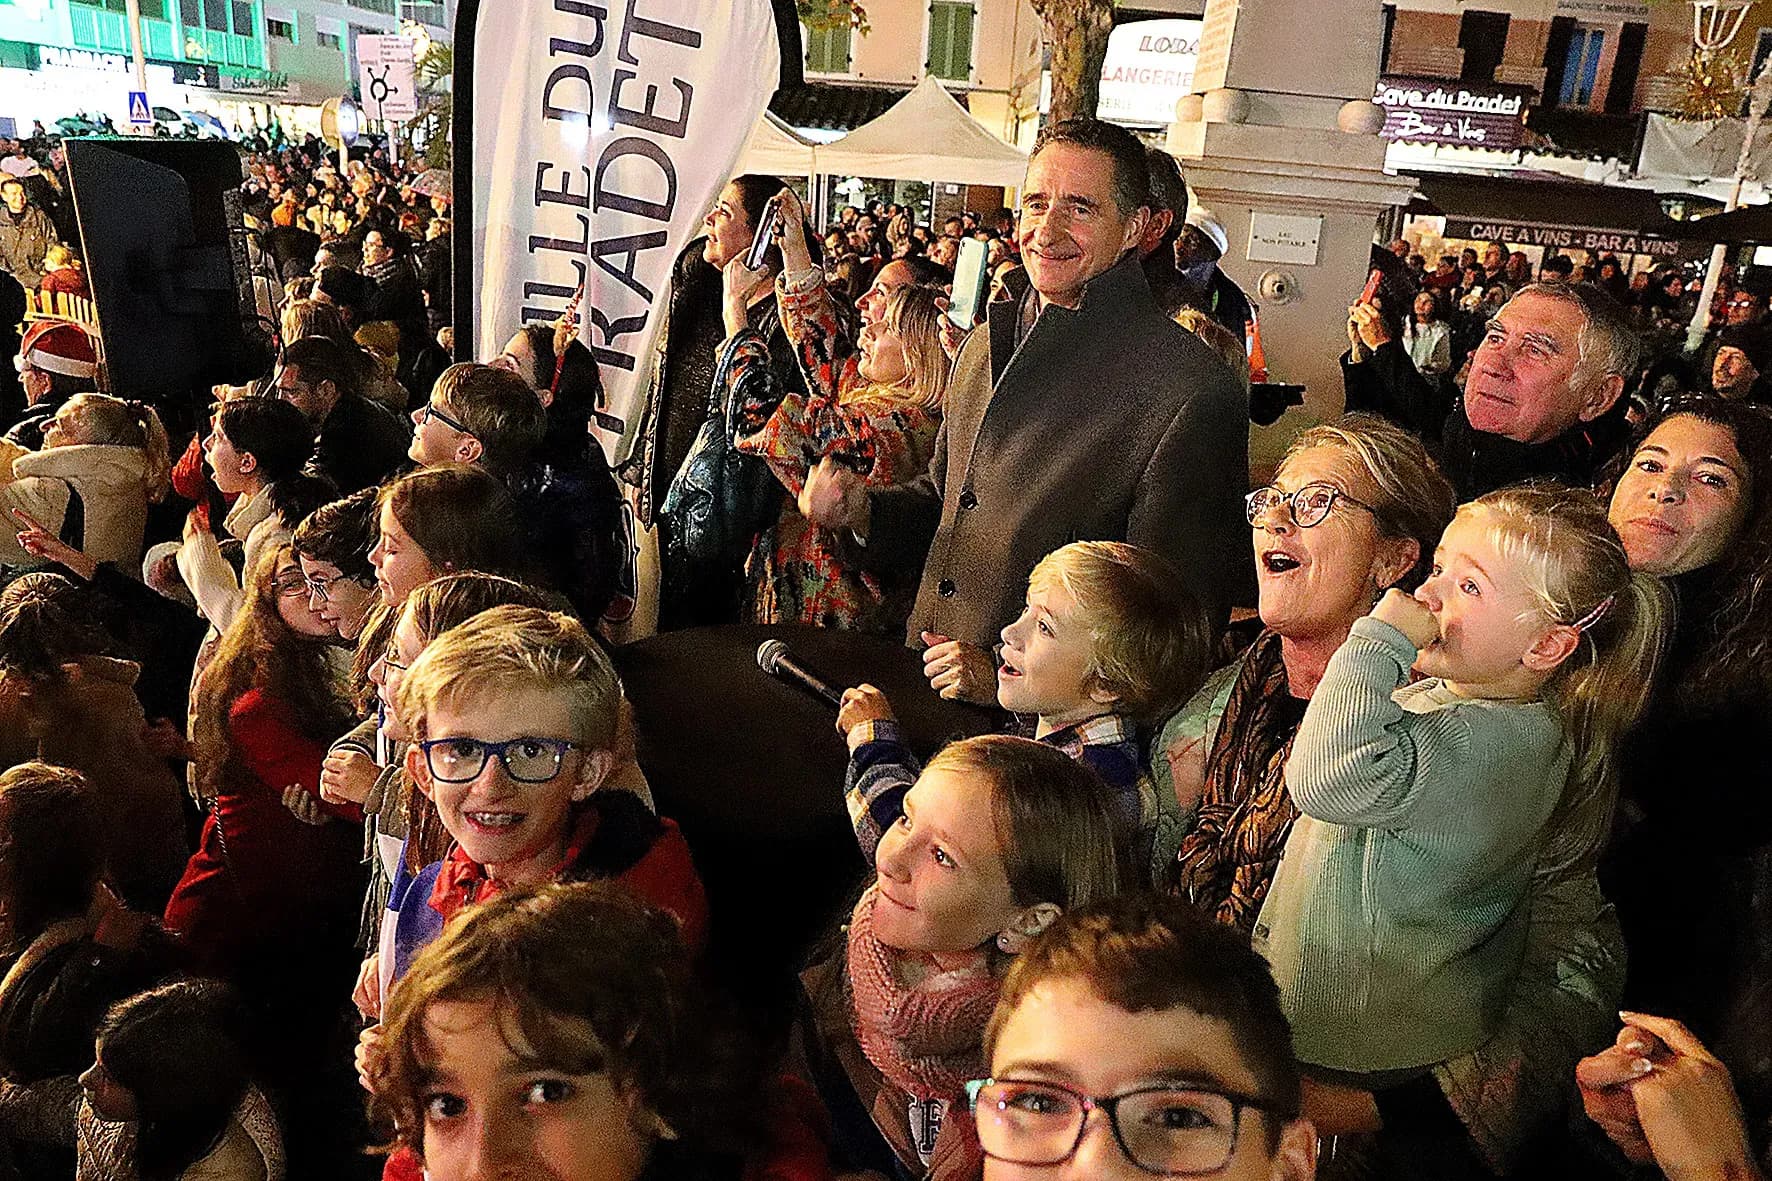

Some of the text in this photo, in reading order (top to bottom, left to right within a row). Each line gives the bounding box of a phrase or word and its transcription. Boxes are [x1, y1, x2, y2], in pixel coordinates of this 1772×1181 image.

[1101, 65, 1193, 87] LANGERIE
[1372, 83, 1522, 115] Cave du Pradet
[521, 0, 607, 325] ILLE DU
[589, 0, 701, 434] RADET
[1470, 224, 1513, 241] CAVE
[1533, 230, 1571, 246] VINS
[1585, 233, 1622, 251] BAR
[1641, 239, 1680, 255] VINS
